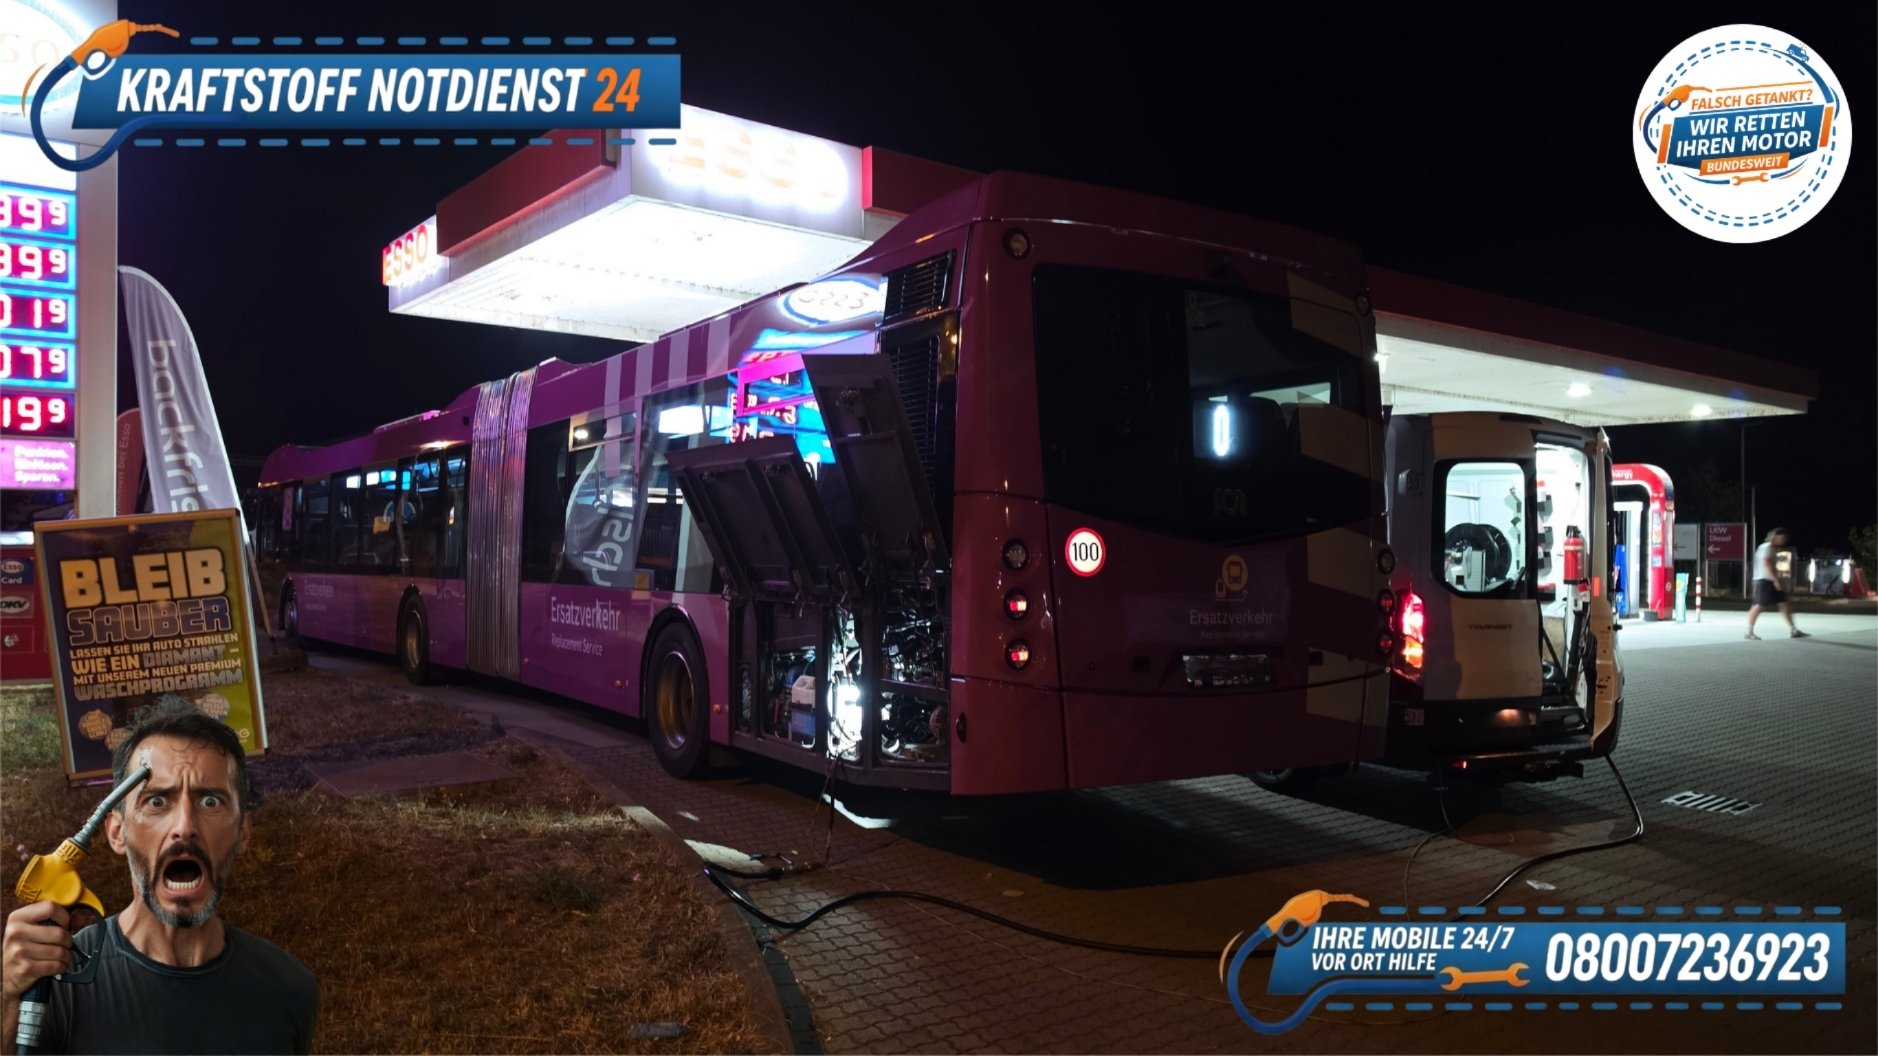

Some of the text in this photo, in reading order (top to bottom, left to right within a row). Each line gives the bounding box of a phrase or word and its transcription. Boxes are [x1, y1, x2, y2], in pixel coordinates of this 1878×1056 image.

[383, 223, 429, 285] ESSO
[120, 423, 131, 449] Esso
[1709, 526, 1728, 534] LKW
[1709, 534, 1731, 542] Diesel
[1072, 541, 1099, 562] 100
[3, 563, 23, 571] Esso
[60, 549, 227, 608] BLEIB
[67, 596, 232, 646] SAUBER
[551, 596, 621, 631] Ersatzverkehr
[1189, 608, 1273, 625] Ersatzverkehr
[69, 632, 239, 659] LASSEN SIE IHR AUTO STRAHLEN
[551, 632, 603, 657] Replacement Service
[71, 658, 107, 675] WIE
[110, 655, 140, 671] EIN
[143, 644, 226, 668] DIAMANT
[73, 658, 241, 686] MIT UNSEREM NEUEN PREMIUM
[74, 668, 243, 702] WASCHPROGRAMM
